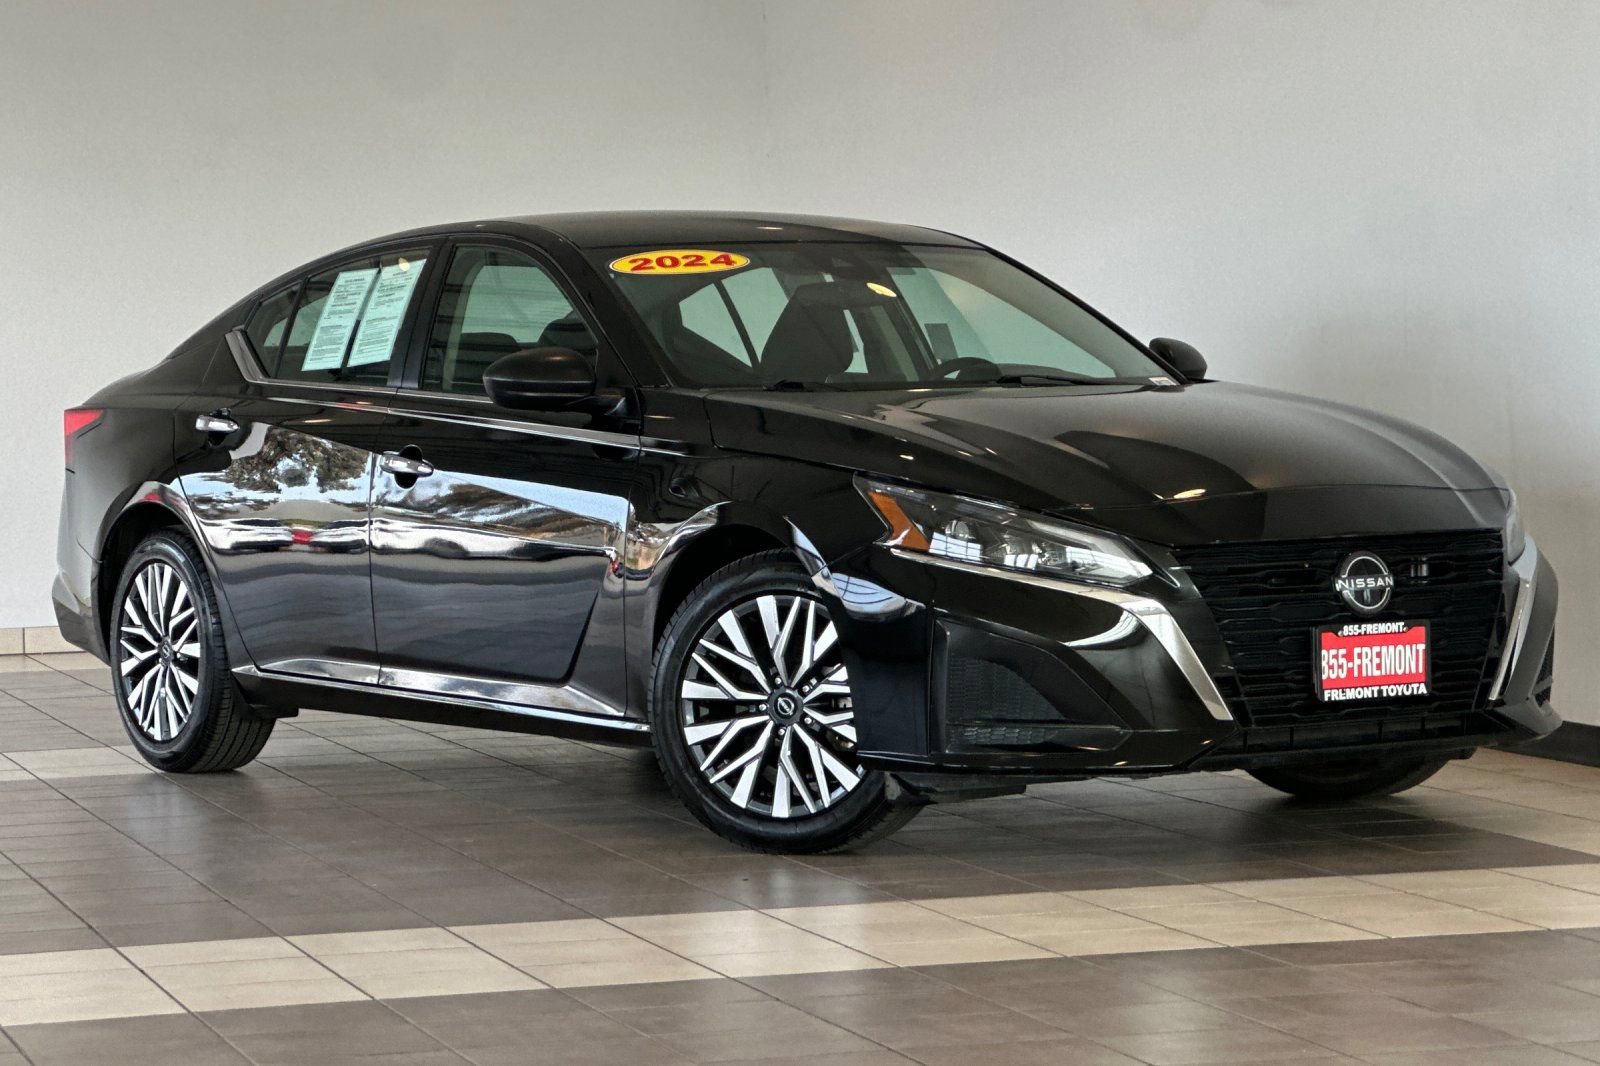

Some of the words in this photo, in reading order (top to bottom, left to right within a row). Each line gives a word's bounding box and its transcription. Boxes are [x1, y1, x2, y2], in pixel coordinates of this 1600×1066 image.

[628, 254, 737, 271] 2024
[1335, 576, 1393, 591] NISSAN
[1343, 622, 1405, 636] 855-FREMONT
[1321, 643, 1426, 680] 855-FREMONT
[1324, 686, 1380, 701] FREMONT
[1381, 682, 1428, 697] TOYOTA
